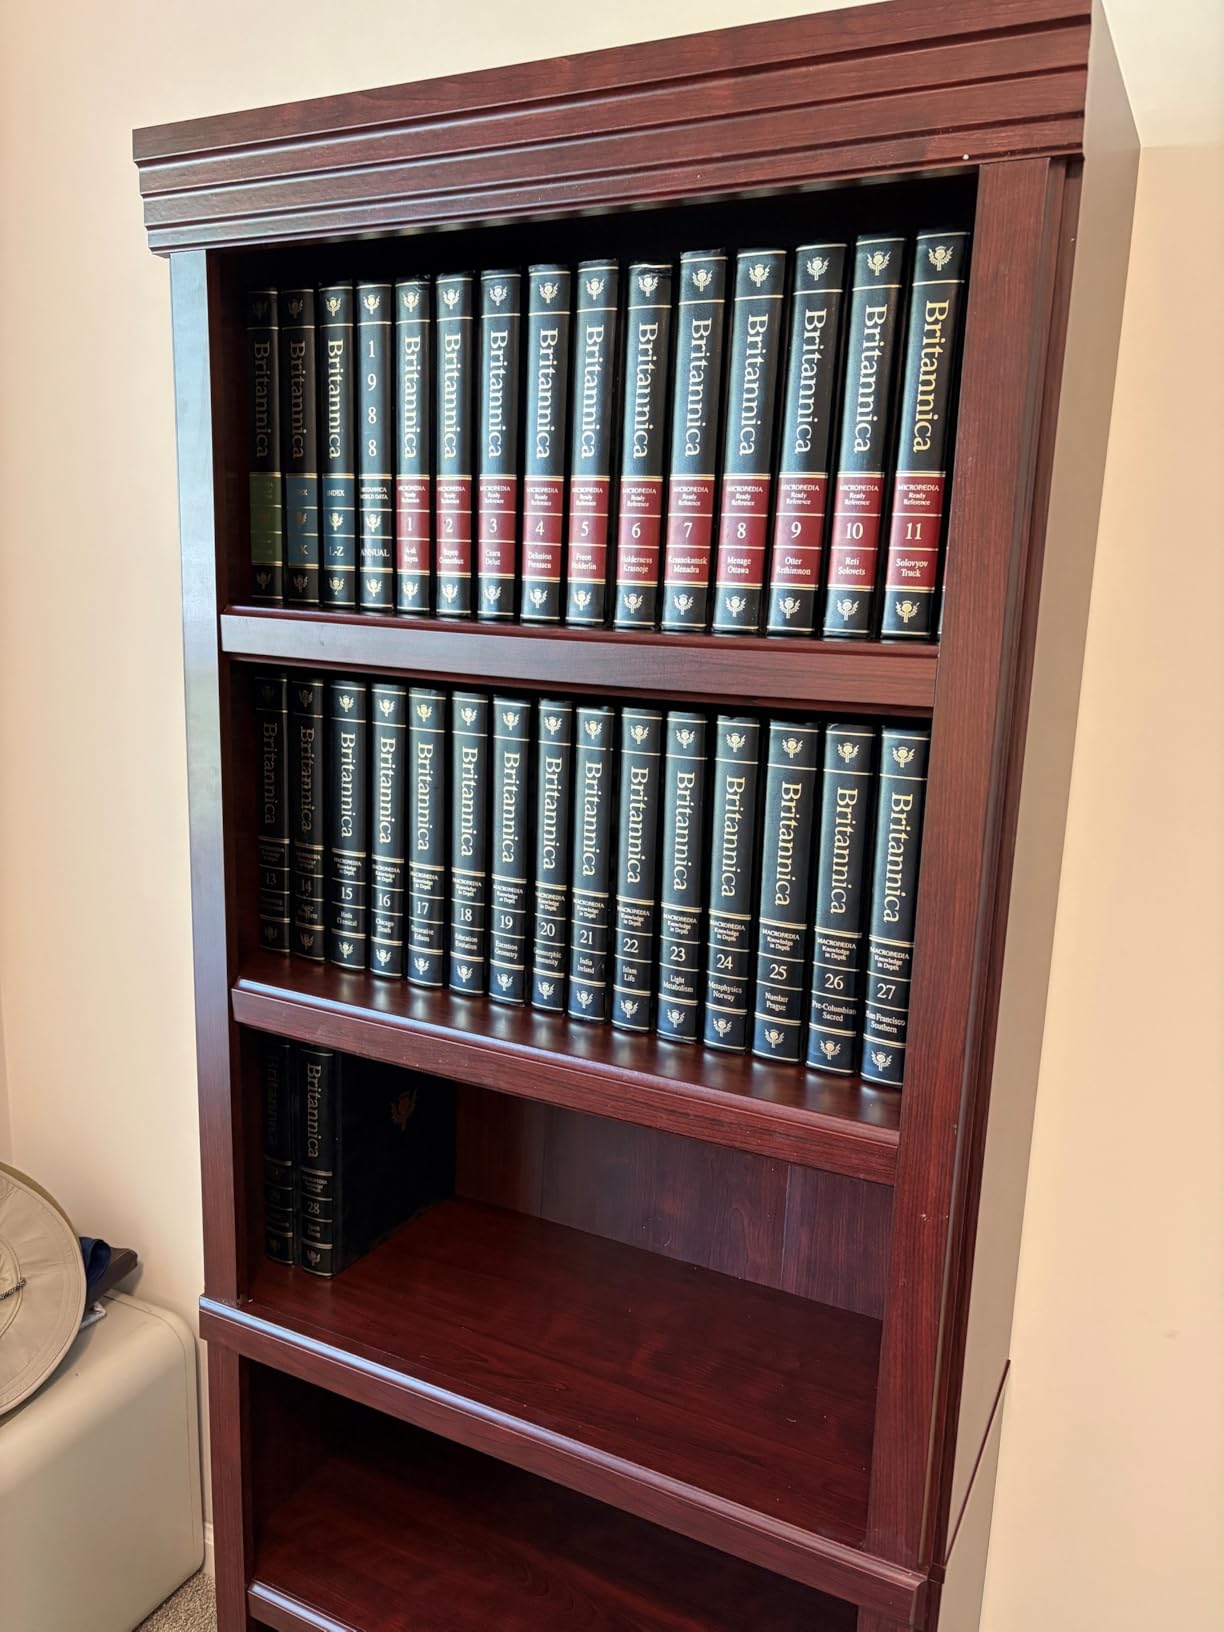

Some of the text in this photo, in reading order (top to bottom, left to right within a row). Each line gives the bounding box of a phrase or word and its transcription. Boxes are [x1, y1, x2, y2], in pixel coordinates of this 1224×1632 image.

[795, 308, 827, 454] Britannica
[853, 304, 888, 454] Britannica
[913, 299, 949, 453] Britannica
[581, 325, 604, 459] Britannica
[633, 322, 658, 459] Britannica
[685, 317, 712, 457] Britannica
[739, 313, 768, 456] Britannica
[290, 341, 307, 459] Britannica
[328, 339, 344, 459] Britannica
[405, 335, 421, 459] Britannica
[444, 332, 461, 458] Britannica
[488, 330, 508, 459] Britannica
[536, 327, 558, 459] Britannica
[850, 492, 866, 500] Ready
[908, 492, 926, 500] Ready
[407, 517, 412, 532] 1
[445, 518, 453, 533] 2
[489, 518, 497, 533] 3
[535, 521, 544, 536] 4
[581, 521, 589, 537] 5
[631, 523, 641, 538] 6
[683, 522, 693, 538] 7
[736, 522, 746, 539] 8
[791, 521, 802, 539] 9
[846, 522, 864, 540] 10
[905, 522, 922, 540] 11
[329, 546, 345, 557] L-Z
[360, 548, 390, 557] ANNUAL
[728, 556, 751, 566] Menage
[896, 558, 928, 568] Solovyov
[728, 566, 749, 574] Ottawa
[837, 567, 866, 576] Solovets
[901, 568, 921, 578] Truck
[263, 722, 278, 824] Britannica
[300, 726, 315, 832] Britannica
[341, 732, 356, 838] Britannica
[380, 737, 396, 844] Britannica
[417, 742, 433, 851] Britannica
[461, 746, 478, 857] Britannica
[502, 751, 520, 863] Britannica
[543, 756, 562, 870] Britannica
[582, 760, 602, 877] Britannica
[627, 766, 648, 884] Britannica
[673, 771, 695, 891] Britannica
[721, 775, 746, 897] Britannica
[775, 781, 802, 906] Britannica
[830, 787, 858, 914] Britannica
[883, 792, 913, 923] Britannica
[266, 872, 277, 885] 13
[341, 886, 353, 900] 15
[378, 893, 391, 907] 16
[417, 901, 429, 915] 17
[460, 908, 472, 921] 18
[500, 915, 513, 929] 19
[540, 922, 555, 937] 20
[580, 930, 593, 945] 21
[623, 938, 639, 953] 22
[775, 944, 790, 952] Depth
[670, 946, 686, 962] 23
[831, 953, 847, 961] Depth
[577, 965, 595, 974] Ireland
[716, 954, 734, 970] 24
[883, 963, 899, 971] Depth
[623, 966, 637, 974] Islam
[624, 973, 635, 982] Life
[769, 964, 788, 980] 25
[670, 974, 685, 984] Light
[708, 980, 743, 993] Metaphysics
[825, 974, 844, 990] 26
[663, 981, 694, 993] Metabolism
[877, 983, 896, 1000] 27
[713, 991, 735, 1002] Norway
[765, 992, 788, 1003] Number
[766, 1001, 786, 1011] Prague
[812, 1000, 856, 1014] Pre-Columbian
[822, 1012, 844, 1022] Sacred
[876, 1013, 905, 1026] Francisco
[871, 1021, 897, 1033] Southern
[307, 1063, 322, 1158] Britannica
[307, 1201, 320, 1215] 28
